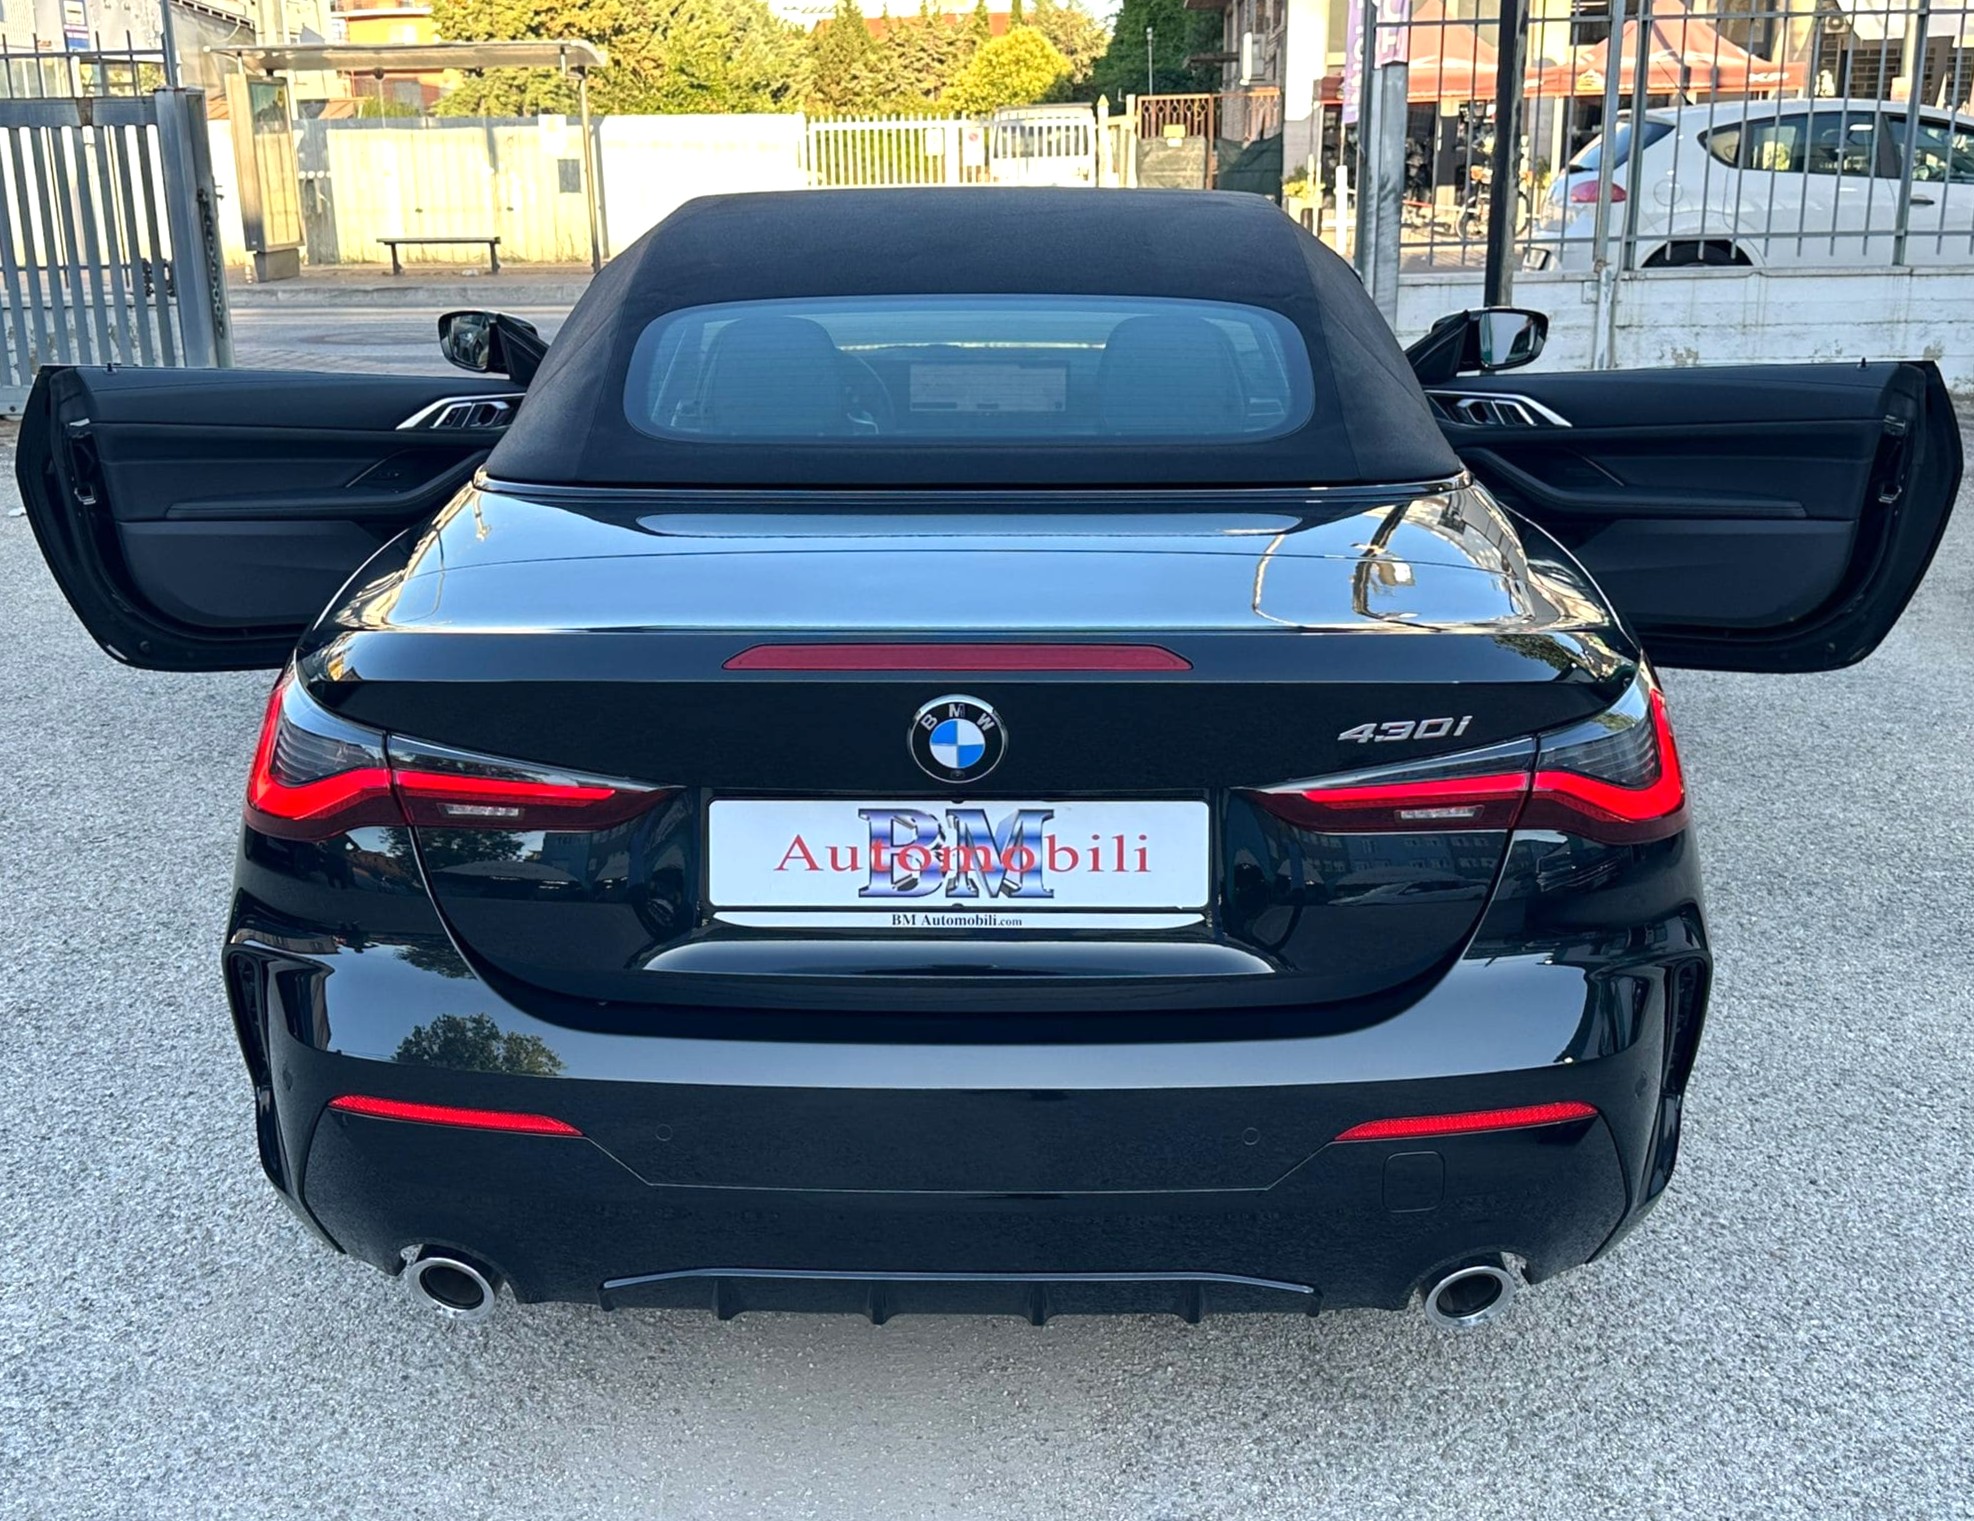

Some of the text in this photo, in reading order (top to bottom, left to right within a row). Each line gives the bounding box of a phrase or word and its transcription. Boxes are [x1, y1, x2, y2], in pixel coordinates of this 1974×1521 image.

[920, 703, 995, 731] BMW
[1337, 715, 1473, 743] 430i
[773, 833, 1152, 873] Automobili
[858, 808, 1055, 899] BM
[891, 914, 1023, 926] BM Automobili.com
